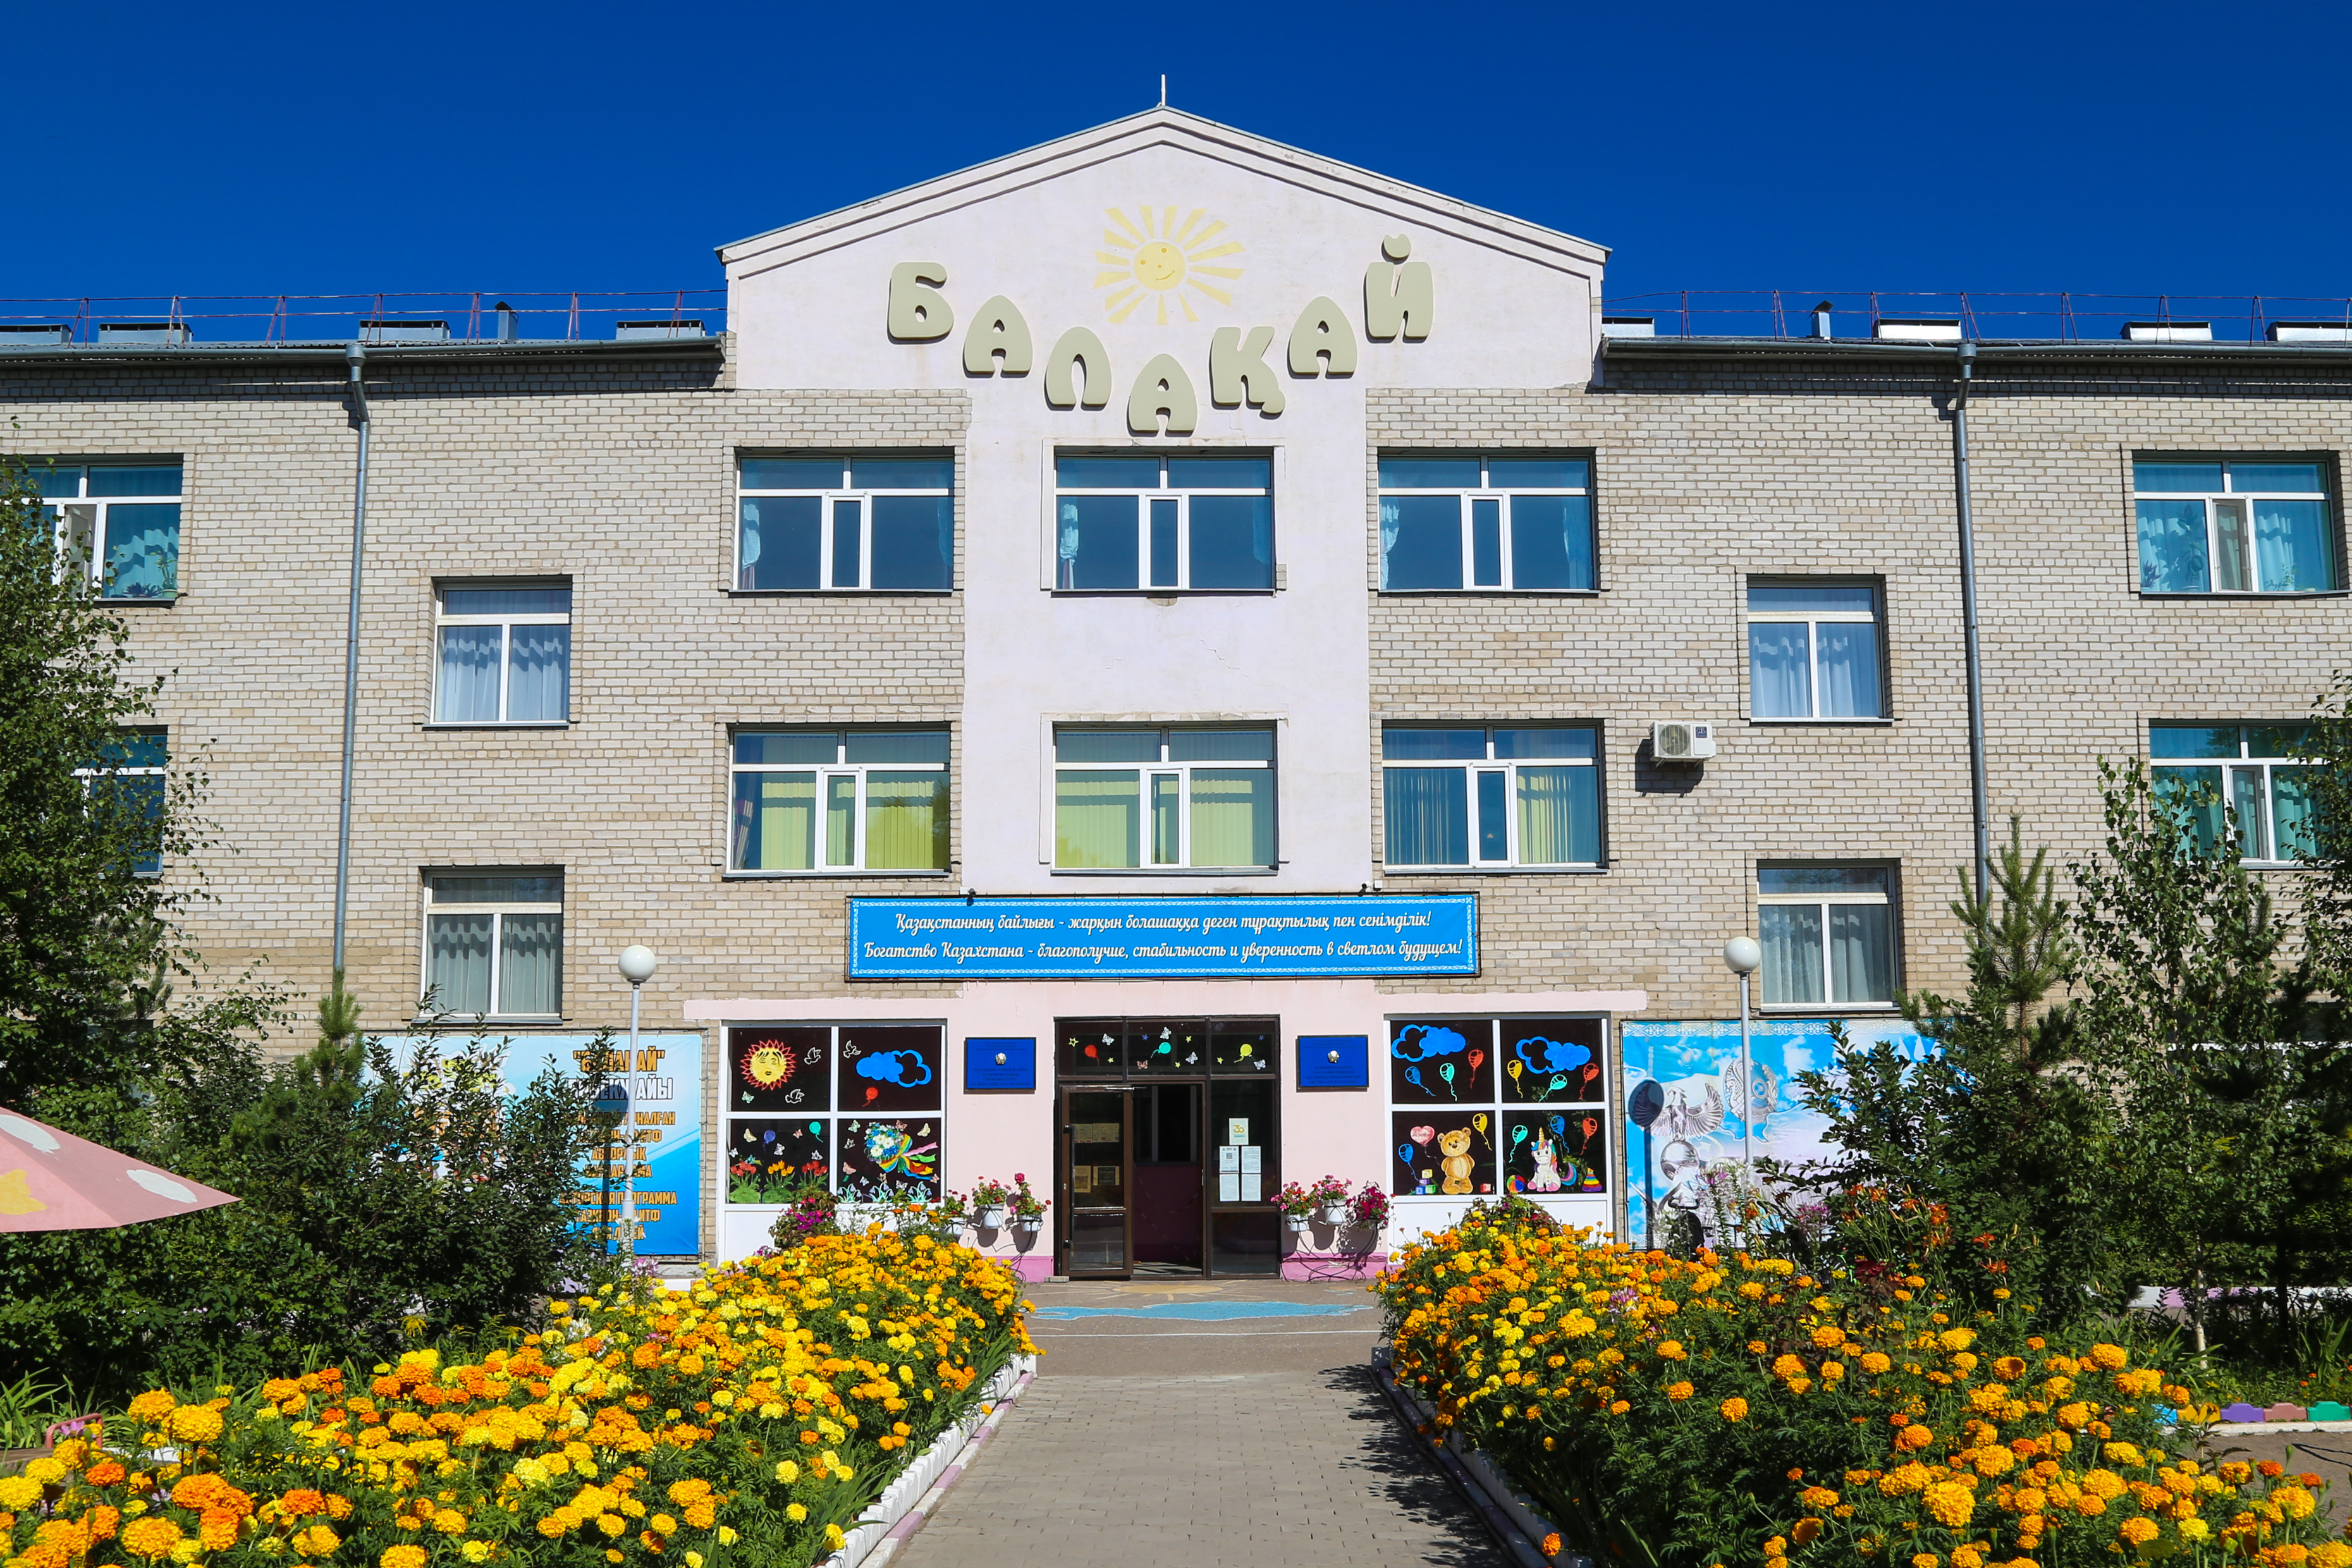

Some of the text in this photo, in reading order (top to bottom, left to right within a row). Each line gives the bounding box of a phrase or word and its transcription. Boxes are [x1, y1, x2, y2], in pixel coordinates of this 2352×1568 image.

[888, 234, 1434, 436] БАЛАҚАЙ
[895, 913, 995, 936] Қазақстанның
[998, 914, 1055, 929] байлығы
[1068, 917, 1123, 936] жарқын
[1125, 914, 1200, 933] болашаққа
[1202, 917, 1238, 935] деген
[1240, 916, 1330, 935] тұрақтылық
[1333, 916, 1356, 928] пен
[1359, 910, 1432, 934] сенімділік!
[864, 941, 937, 958] Богатство
[941, 941, 1024, 965] Казахстана
[1037, 943, 1129, 965] благополучие,
[1132, 943, 1227, 957] стабильность
[1230, 946, 1239, 957] и
[1240, 941, 1323, 964] уверенность
[1326, 941, 1334, 956] в
[1337, 940, 1396, 956] светлом
[1399, 938, 1463, 962] будущем!
[573, 1046, 666, 1072] "БЛААЙ"
[567, 1074, 673, 1100] ЕКЖАЙЫ
[617, 1191, 677, 1204] ПОГРАММА
